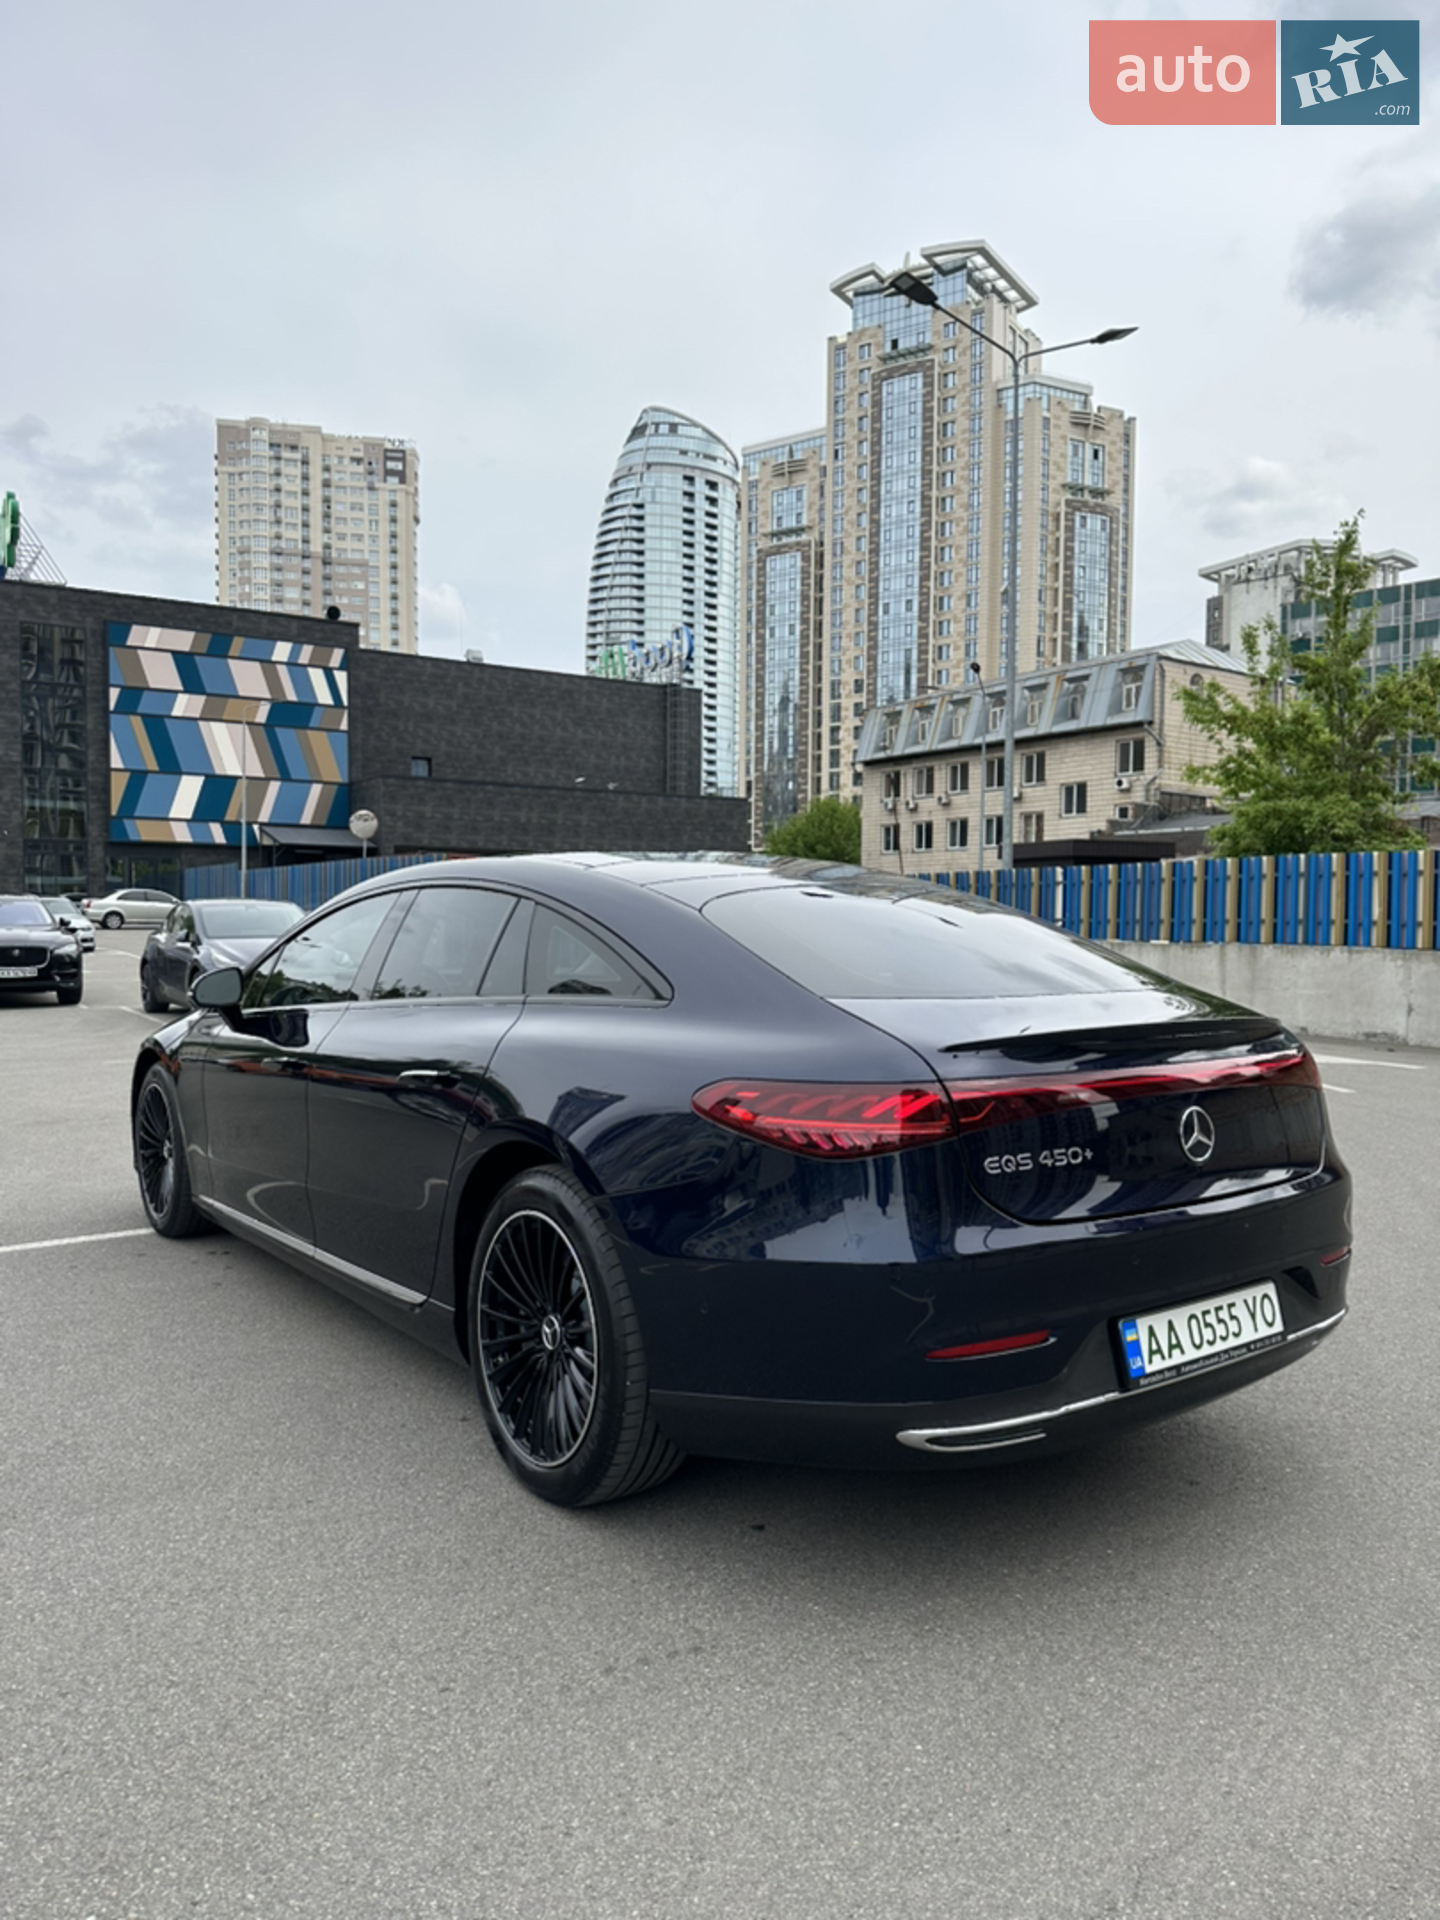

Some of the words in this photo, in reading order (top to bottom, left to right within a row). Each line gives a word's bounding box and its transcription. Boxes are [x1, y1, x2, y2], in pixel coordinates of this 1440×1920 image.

[983, 1152, 1034, 1174] EQS
[1038, 1146, 1094, 1168] 450+
[1146, 1319, 1186, 1365] AA
[1186, 1302, 1242, 1350] 0555
[1243, 1292, 1276, 1333] YO
[1129, 1356, 1143, 1370] UA
